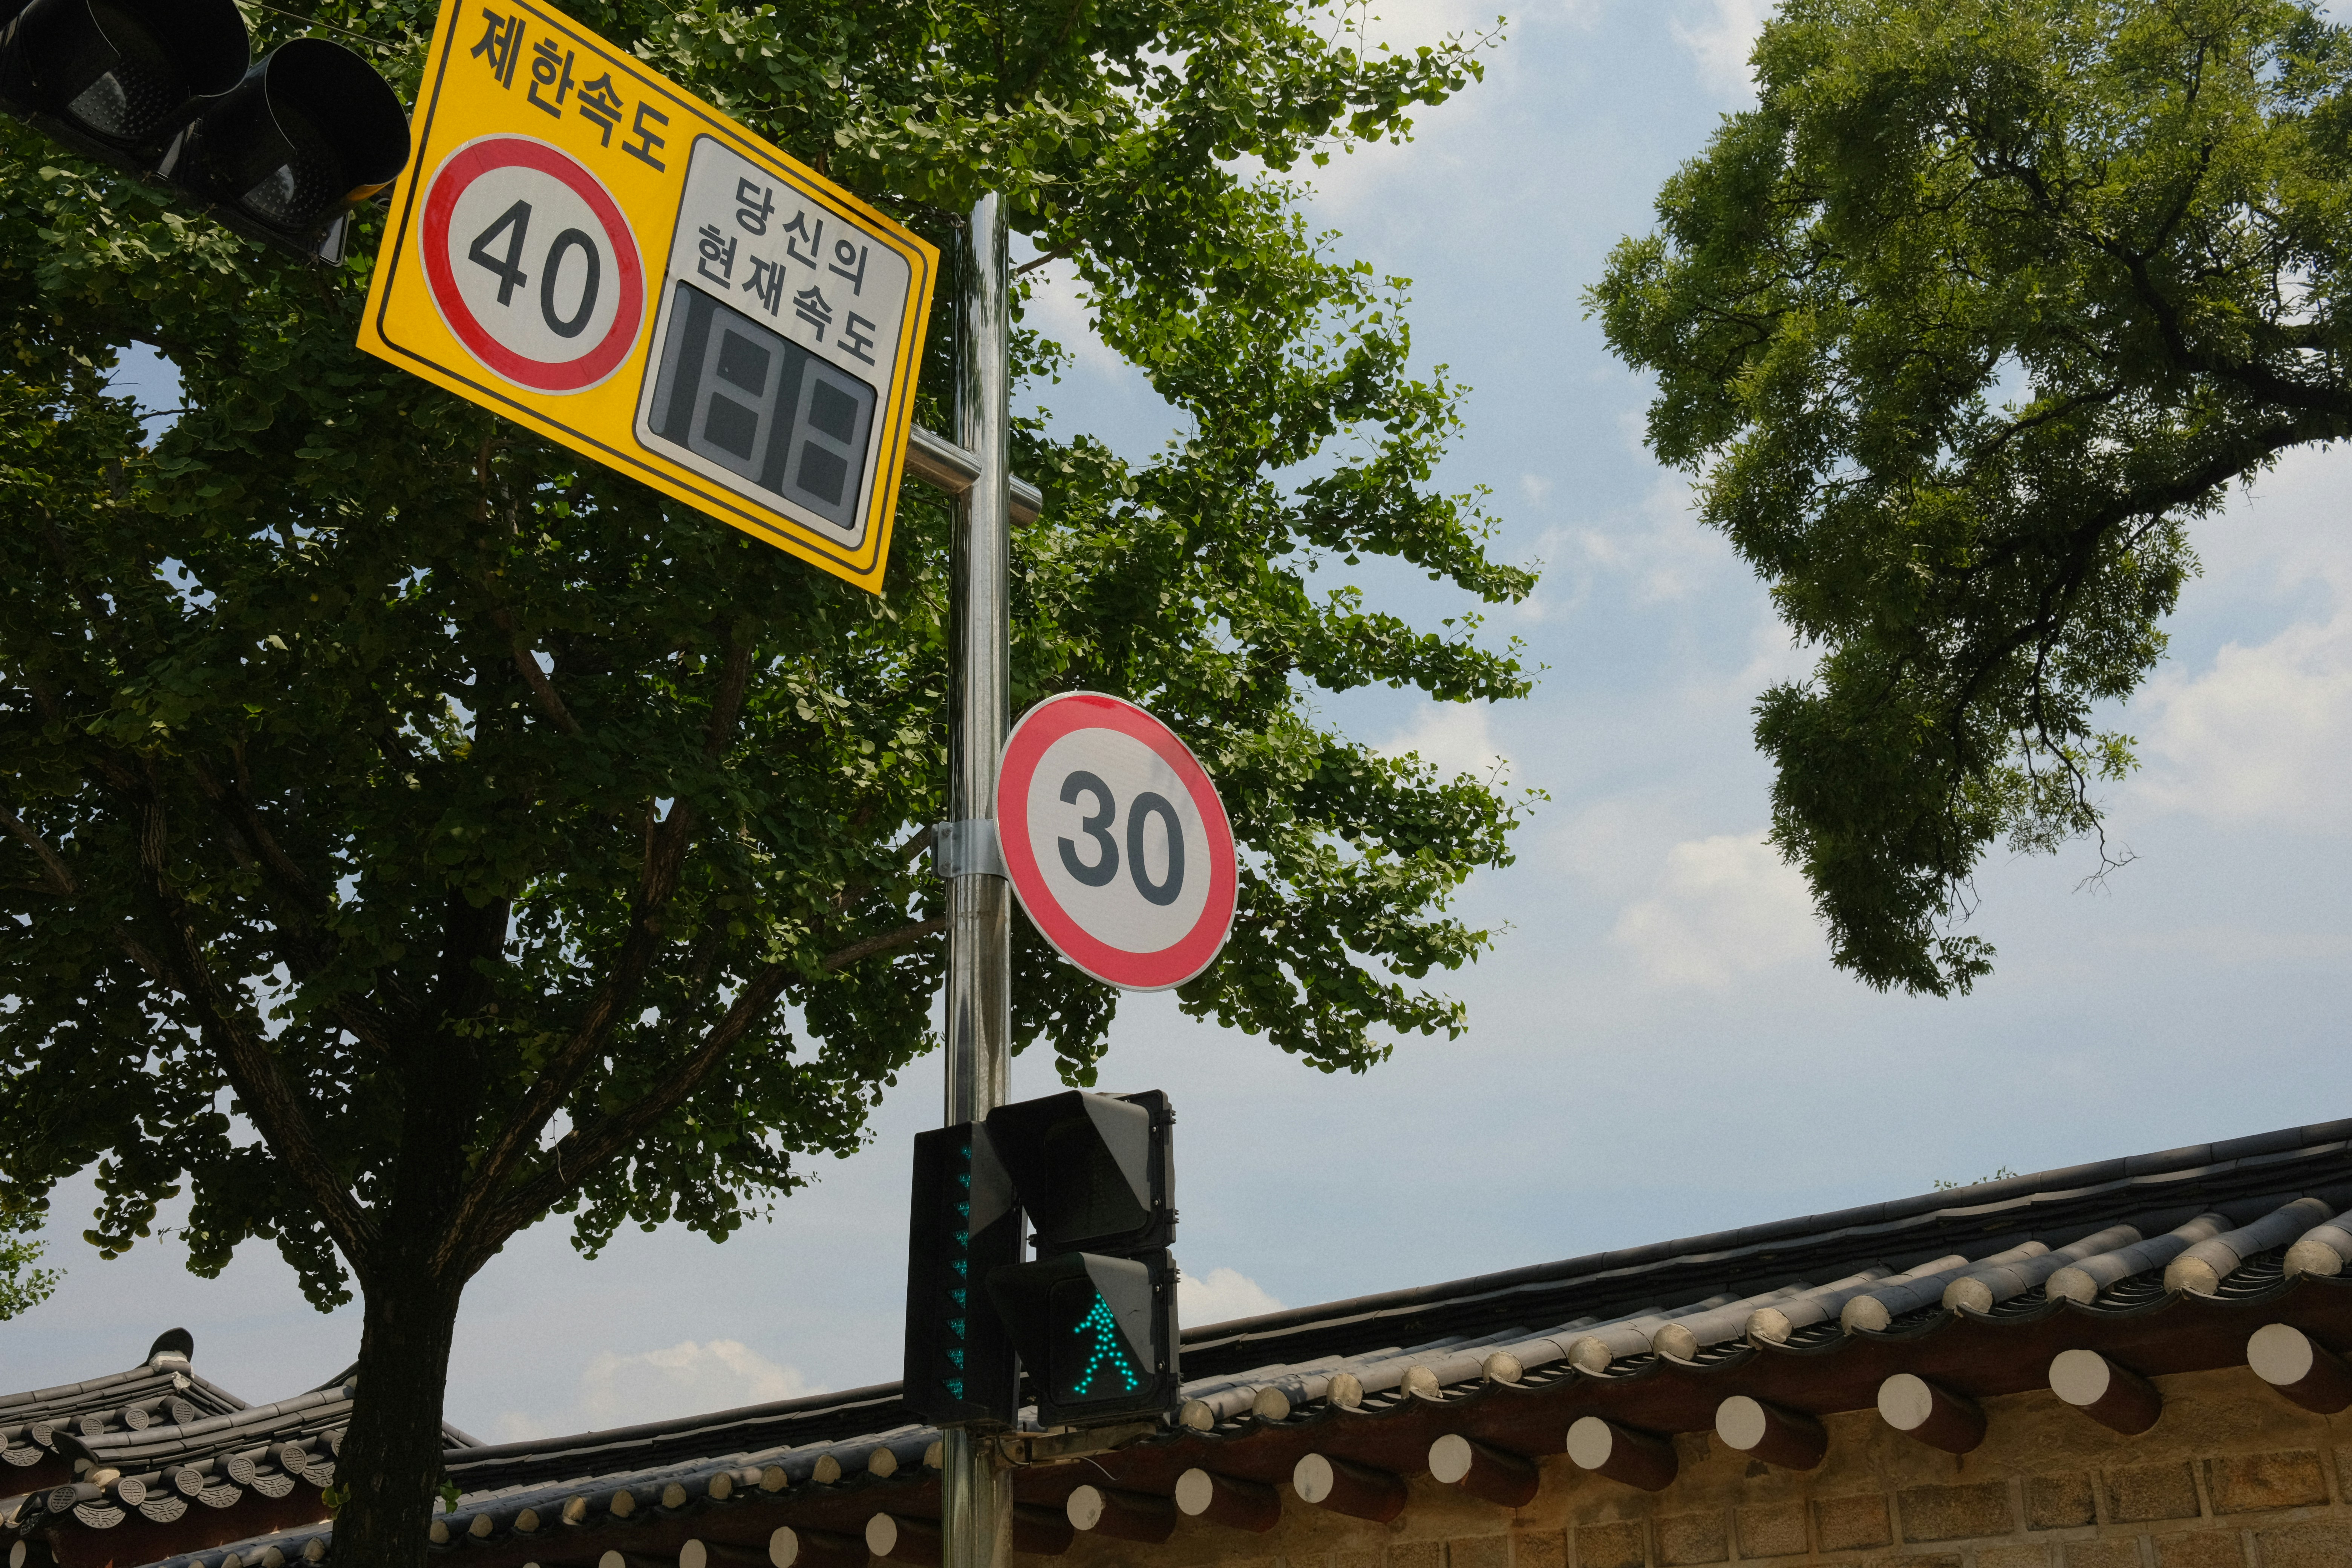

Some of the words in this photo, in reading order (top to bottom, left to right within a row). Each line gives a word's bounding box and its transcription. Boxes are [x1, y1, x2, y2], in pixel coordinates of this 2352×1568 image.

[470, 11, 670, 173] 제한속도
[468, 199, 601, 338] 40
[697, 224, 876, 367] 현재속도
[735, 176, 868, 296] 당신의
[1058, 770, 1185, 906] 30
